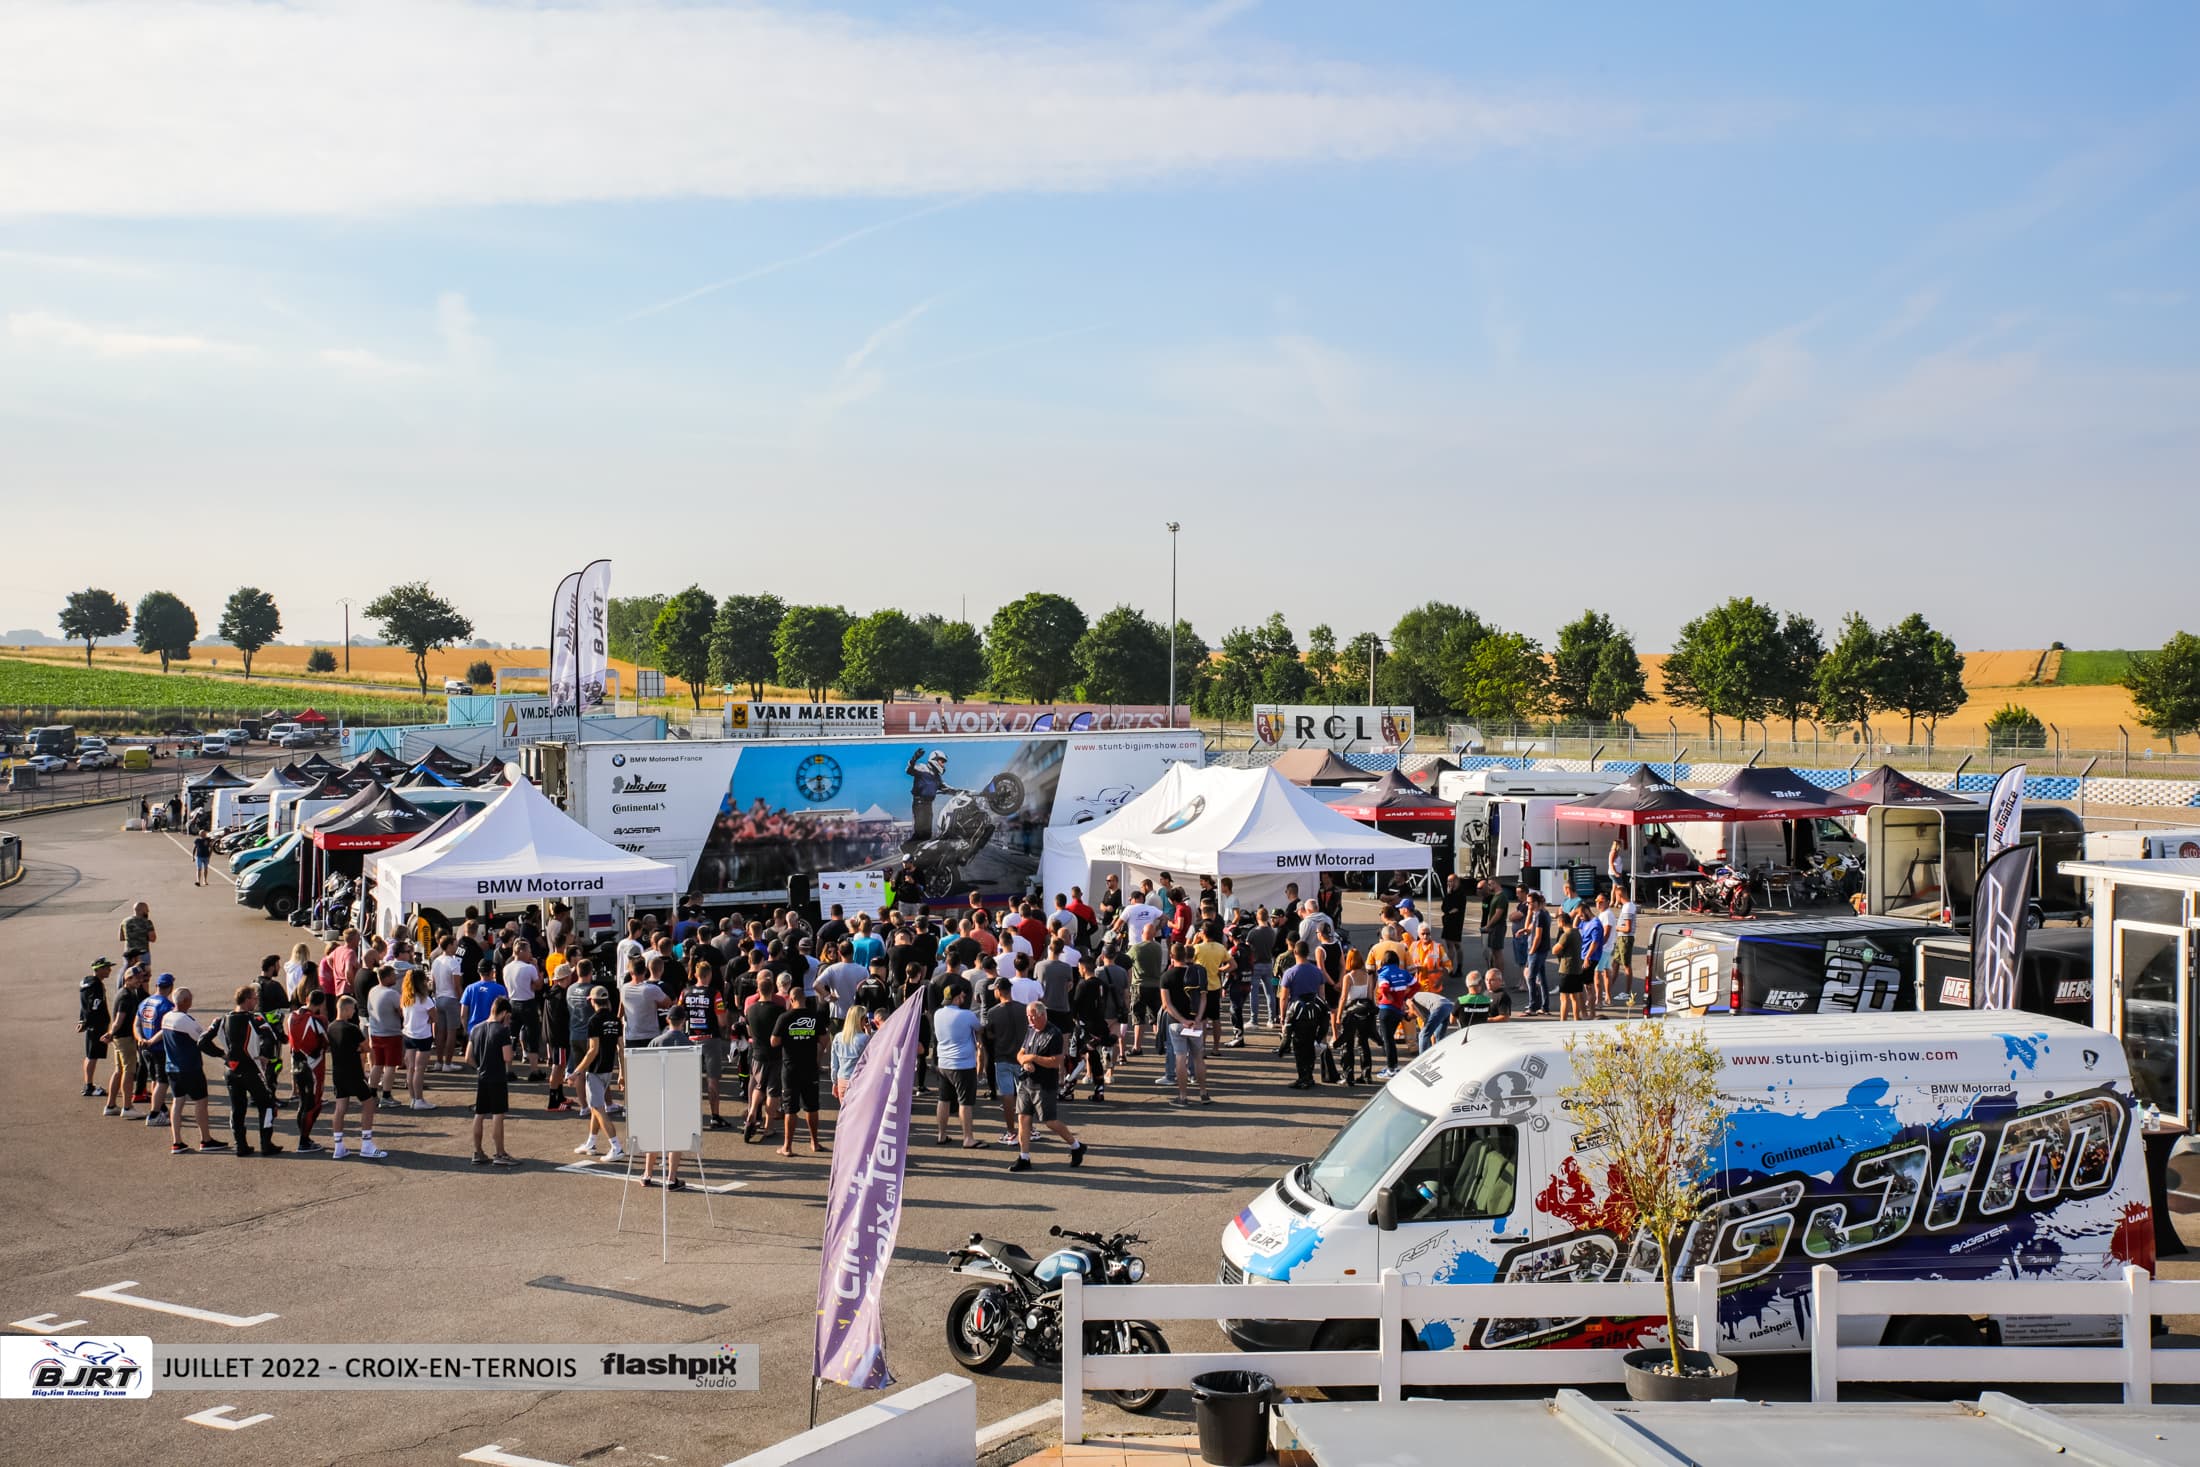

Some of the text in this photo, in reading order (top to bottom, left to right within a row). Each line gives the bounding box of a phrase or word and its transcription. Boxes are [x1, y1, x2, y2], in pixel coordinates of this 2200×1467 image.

[593, 591, 605, 656] BJRT
[754, 706, 878, 719] VAN MAERCKE
[1295, 715, 1372, 740] RCL
[1073, 742, 1197, 751] www.stunt-bigjim-show.com
[1771, 790, 1801, 798] Bihr
[612, 803, 658, 814] Continental
[1993, 791, 2018, 843] puissance
[614, 827, 661, 835] BAGSTER
[1412, 832, 1448, 844] Bihr
[1277, 853, 1375, 867] BMW Motorrad
[477, 876, 604, 894] BMW Motorrad
[1665, 953, 1719, 1013] 20
[1817, 957, 1901, 1013] 20
[685, 995, 710, 1006] aprilia
[1731, 1050, 1958, 1066] www.stunt-bigjim-show.com
[1931, 1083, 2011, 1094] BMW Motorrad
[1932, 1094, 1969, 1103] France
[1452, 1103, 1488, 1113] SENA
[1761, 1137, 1836, 1169] Continental
[1860, 1138, 1920, 1158] Show Stunt
[887, 1184, 896, 1204] EN
[2128, 1210, 2149, 1224] UAM
[1251, 1232, 1282, 1250] BJRT
[1949, 1223, 2010, 1253] BAGSTER
[1395, 1229, 1449, 1268] RST
[1749, 1320, 1793, 1340] flashpix
